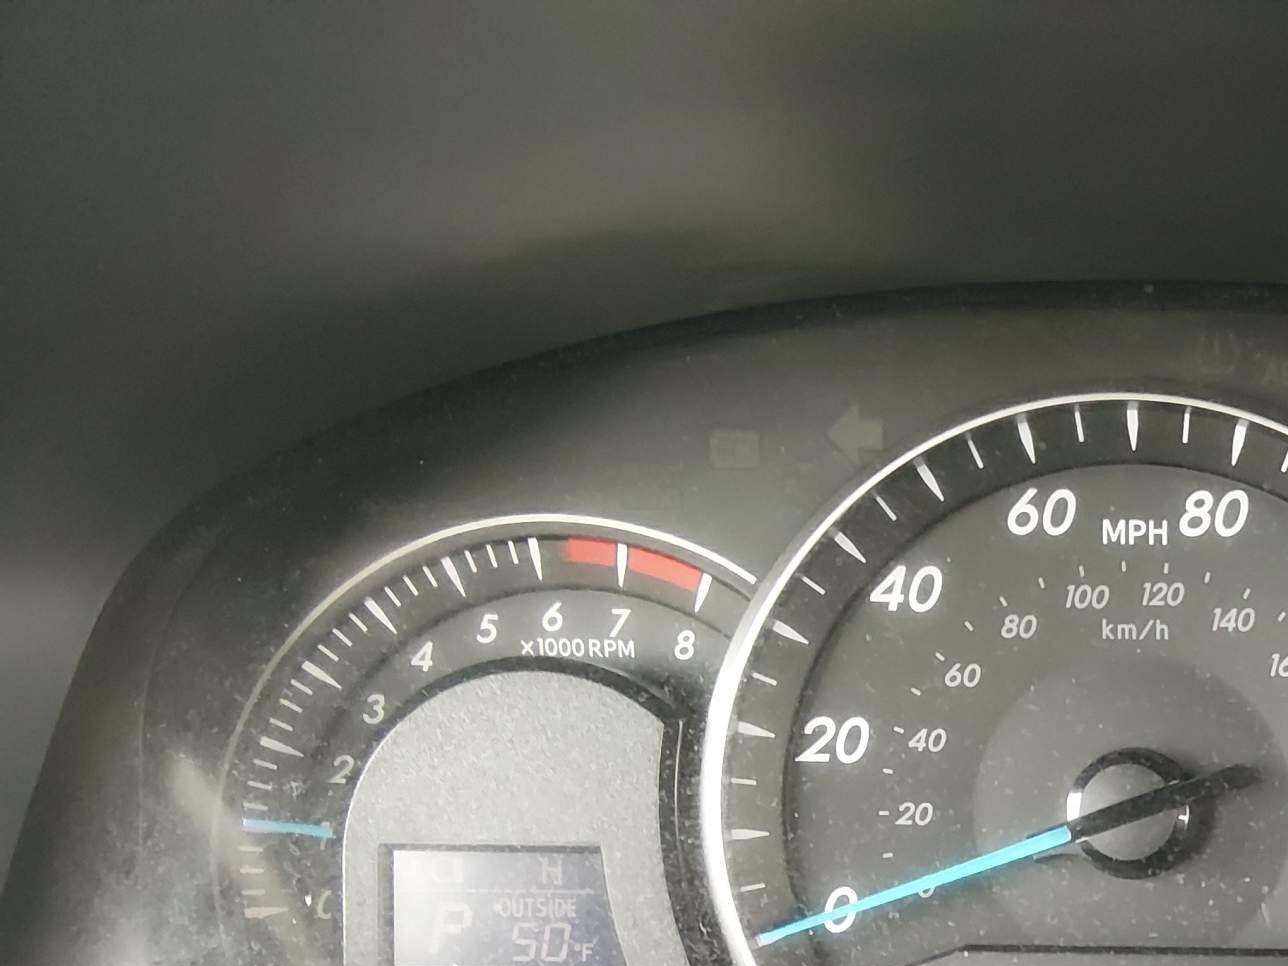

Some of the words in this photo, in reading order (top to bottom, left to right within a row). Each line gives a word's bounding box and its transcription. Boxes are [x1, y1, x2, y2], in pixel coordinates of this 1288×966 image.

[1006, 488, 1077, 537] 60
[1178, 488, 1250, 538] 80
[1101, 519, 1169, 546] MPH
[870, 564, 944, 614] 40
[1065, 584, 1110, 610] 100
[1141, 580, 1185, 607] 120
[476, 614, 499, 644] 5
[542, 602, 564, 631] 6
[609, 609, 632, 638] 7
[1001, 614, 1038, 641] 80
[1101, 618, 1170, 642] km/h
[1211, 606, 1256, 633] 140
[411, 641, 434, 672] 4
[588, 639, 636, 658] RPM
[674, 630, 696, 660] 8
[944, 662, 982, 689] 60
[362, 694, 385, 724] 3
[795, 716, 870, 764] 20
[908, 727, 947, 754] 40
[330, 756, 354, 785] 2
[895, 801, 933, 828] 20
[500, 898, 577, 919] OUTSIDE
[824, 885, 858, 934] 0
[430, 905, 473, 950] P
[511, 923, 569, 964] 50
